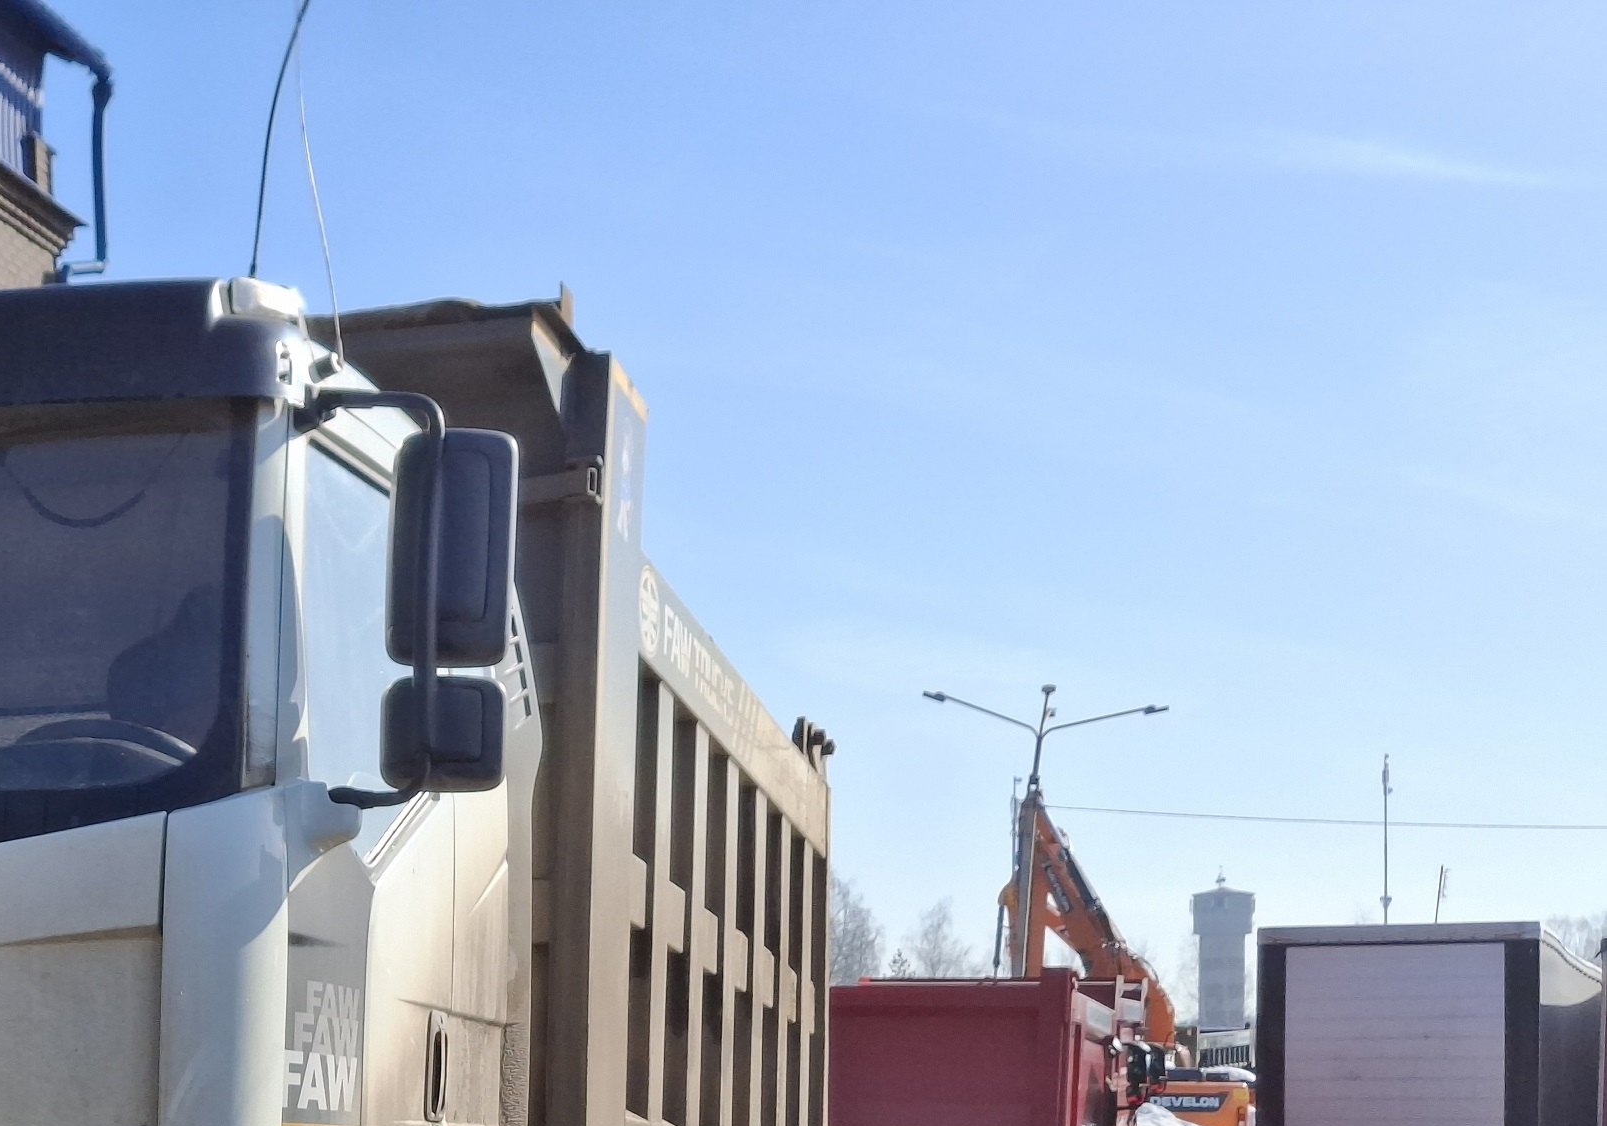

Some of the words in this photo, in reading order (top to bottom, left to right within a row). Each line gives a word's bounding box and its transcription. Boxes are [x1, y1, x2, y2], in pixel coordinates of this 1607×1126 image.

[664, 604, 691, 678] FAW
[306, 980, 359, 1020] FAW
[294, 1012, 359, 1060] FAW
[282, 1049, 357, 1111] FAW
[1150, 1096, 1219, 1107] DEVELON
